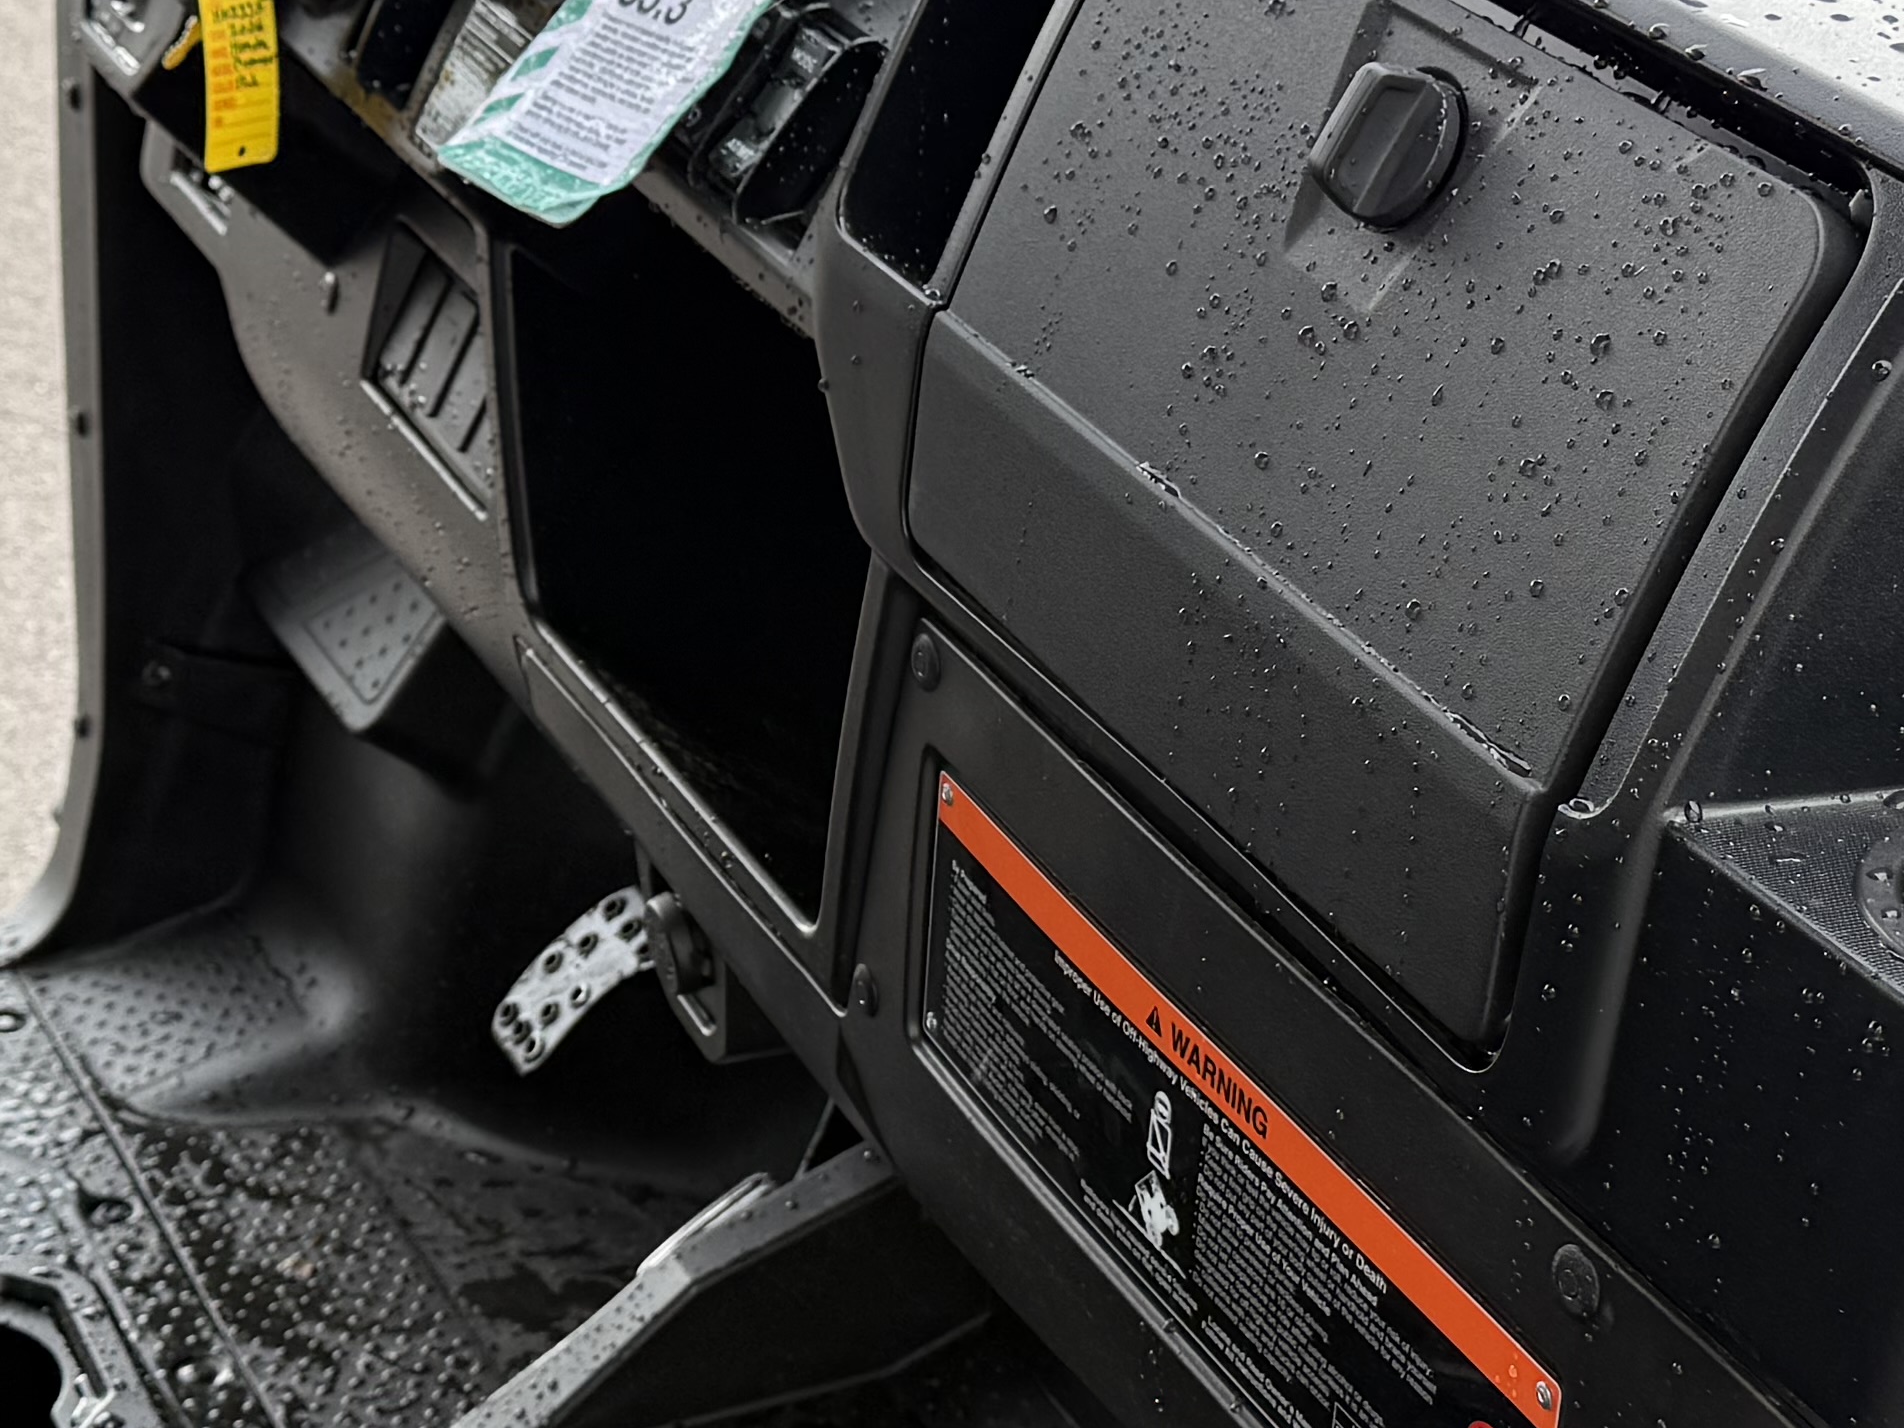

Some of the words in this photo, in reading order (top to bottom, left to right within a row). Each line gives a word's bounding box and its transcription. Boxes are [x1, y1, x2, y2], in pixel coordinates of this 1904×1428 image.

[1054, 949, 1091, 996] Improper
[1093, 989, 1110, 1016] Use
[1111, 1011, 1121, 1026] of
[1122, 1020, 1177, 1084] Off-Highway
[1180, 1075, 1218, 1124] Vehicles
[1220, 1117, 1240, 1145] Can
[1241, 1139, 1273, 1178] Cause
[1274, 1171, 1309, 1215] Severe
[1310, 1207, 1339, 1248] Injury
[1341, 1243, 1353, 1259] or
[1355, 1252, 1386, 1293] Death
[1171, 1022, 1267, 1139] WARNING
[1197, 1172, 1227, 1209] Require
[1227, 1204, 1254, 1236] Proper
[1255, 1231, 1271, 1254] Use
[1271, 1251, 1281, 1264] of
[1281, 1258, 1300, 1284] Your
[1301, 1278, 1330, 1316] Vehicle
[1203, 1123, 1214, 1141] Be
[1214, 1135, 1233, 1160] Sure
[1234, 1154, 1259, 1186] Riders
[1260, 1181, 1276, 1204] Pay
[1276, 1198, 1312, 1241] Attention
[1313, 1237, 1330, 1258] and
[1330, 1252, 1349, 1278] Plan
[1349, 1273, 1377, 1306] Ahead
